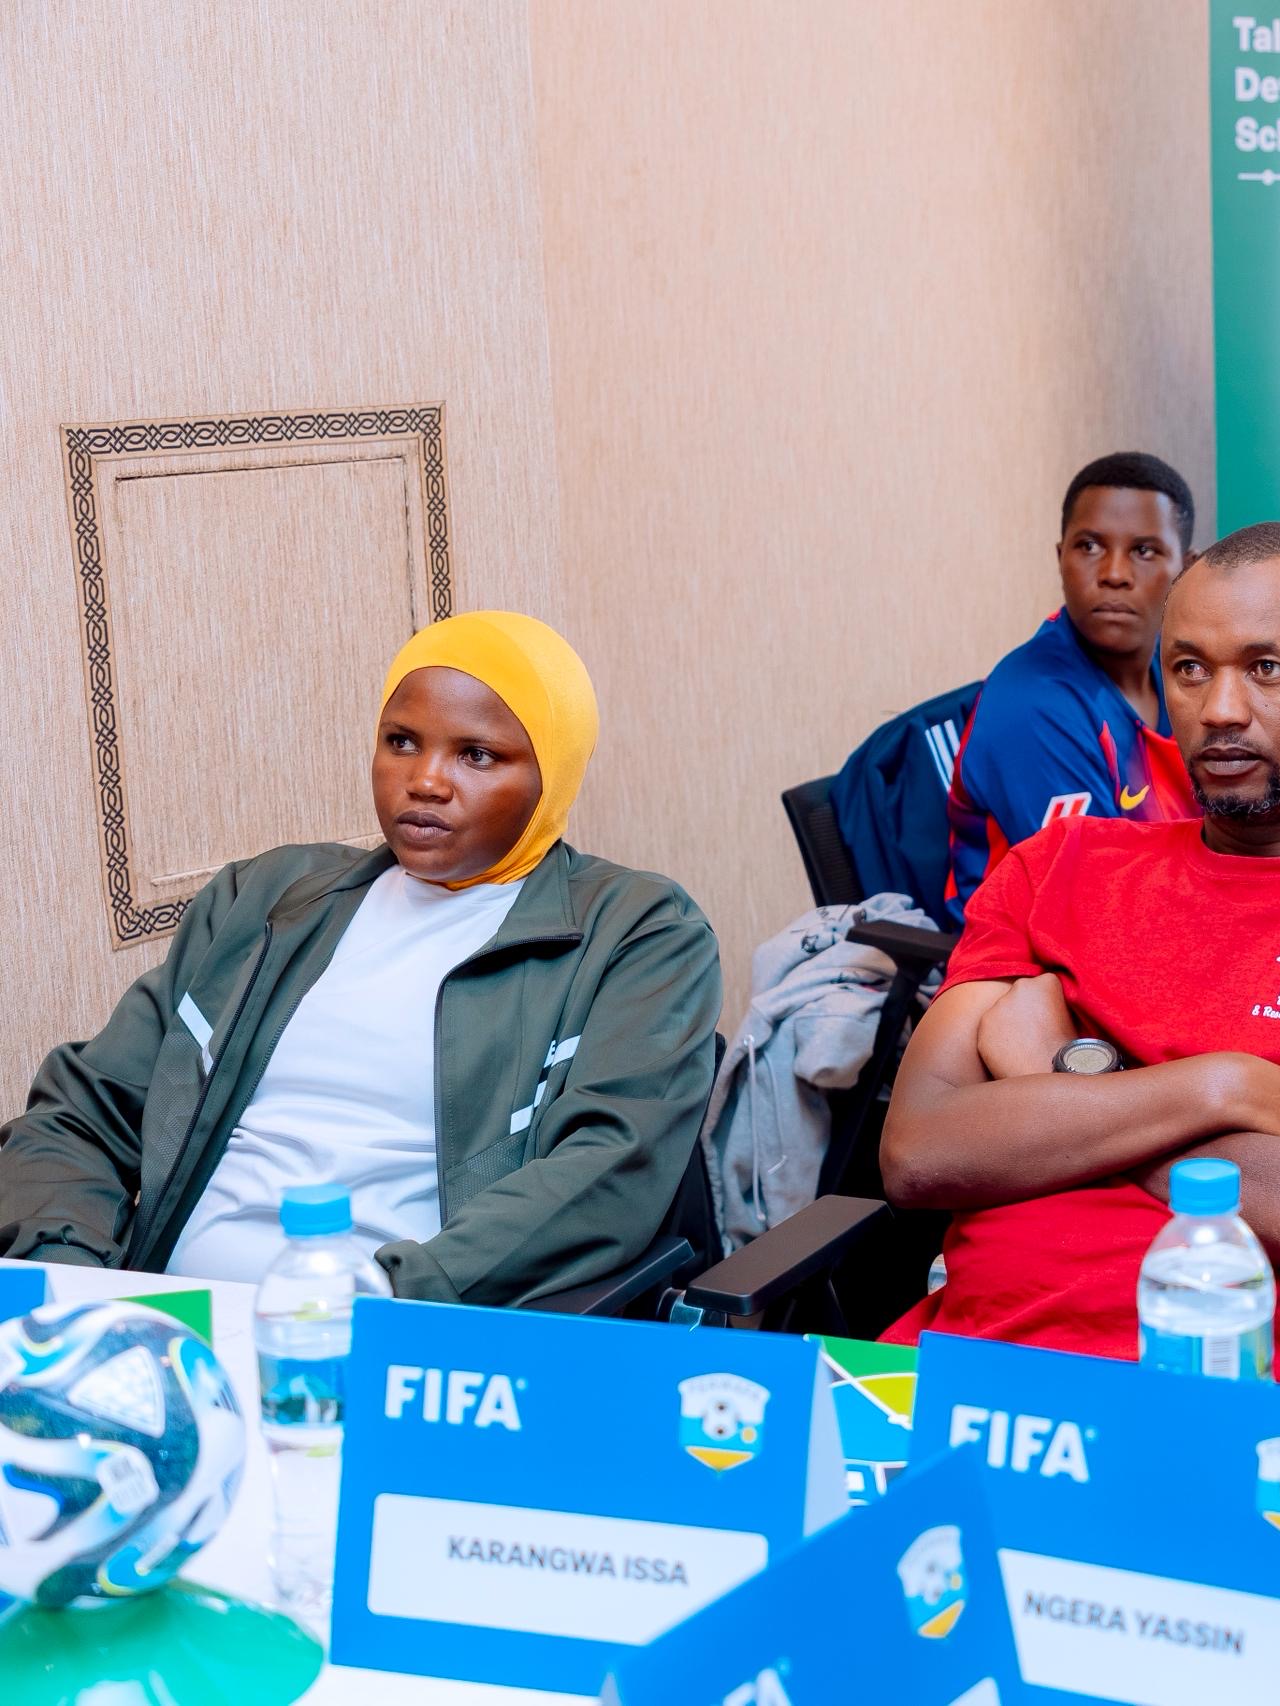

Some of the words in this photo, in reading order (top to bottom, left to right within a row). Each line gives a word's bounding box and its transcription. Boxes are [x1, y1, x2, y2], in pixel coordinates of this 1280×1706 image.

[385, 1364, 522, 1431] FIFA
[949, 1403, 1089, 1483] FIFA
[447, 1535, 615, 1580] KARANGWA
[623, 1555, 689, 1586] ISSA
[1023, 1589, 1125, 1633] NGERA
[1135, 1608, 1244, 1655] YASSIN
